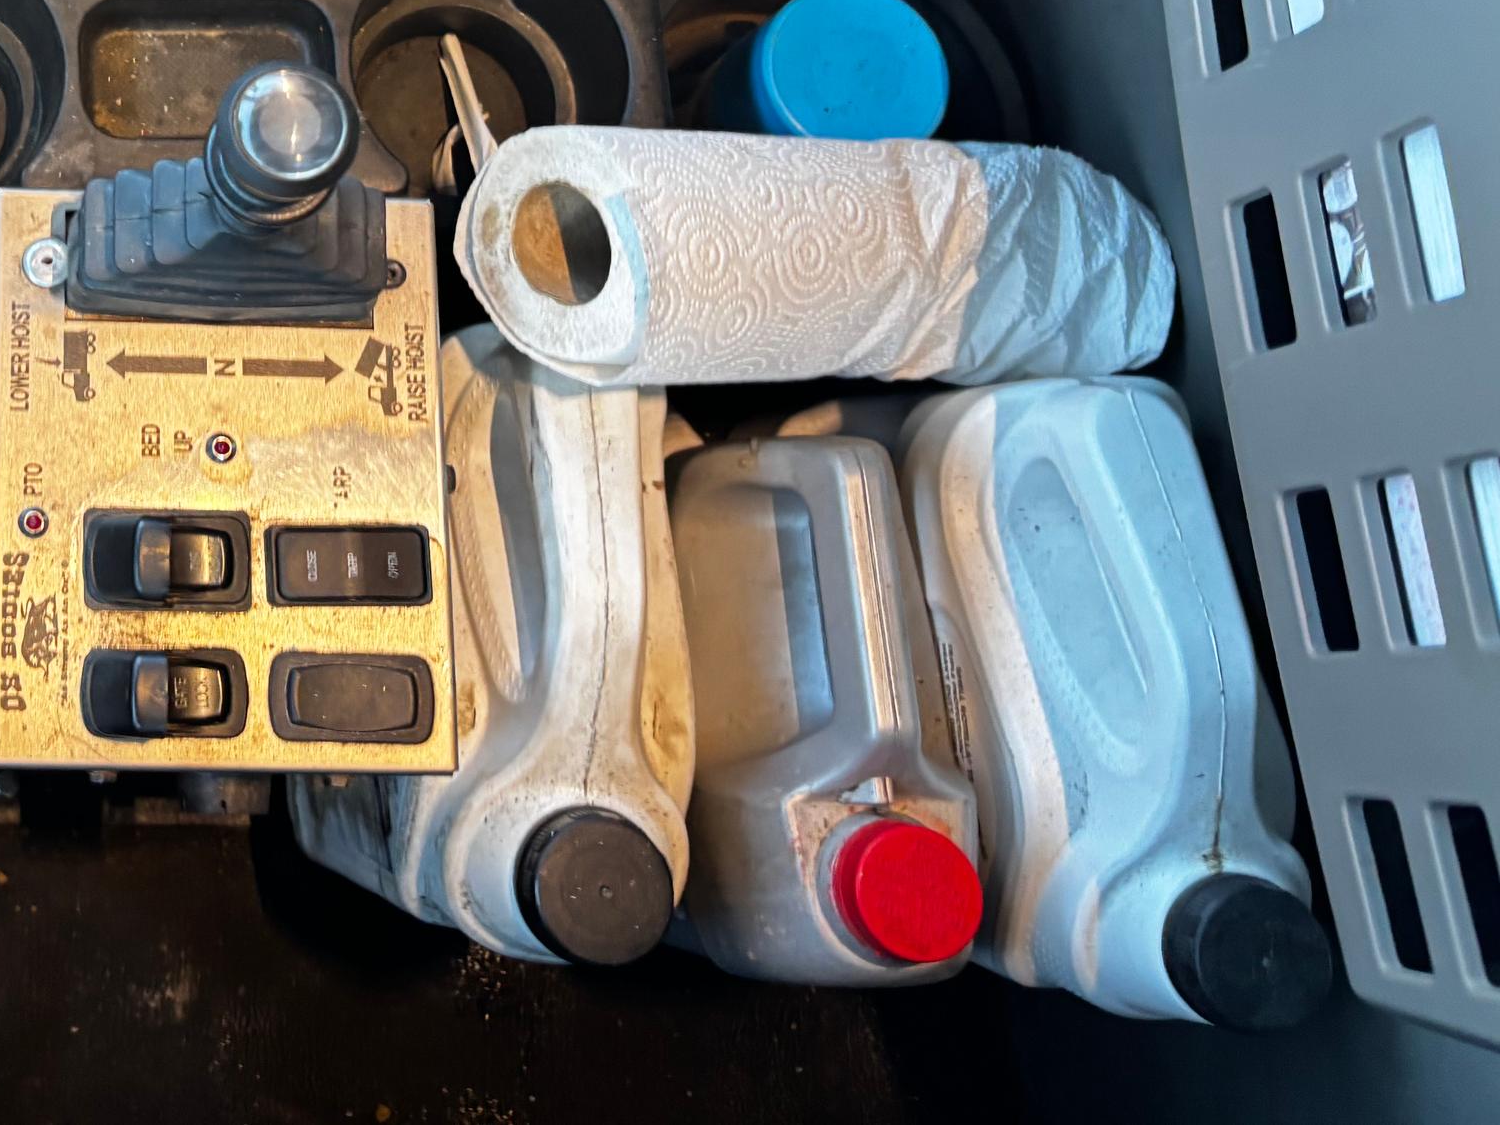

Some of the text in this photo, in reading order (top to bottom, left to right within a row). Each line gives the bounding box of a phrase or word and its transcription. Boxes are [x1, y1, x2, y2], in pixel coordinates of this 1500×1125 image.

[10, 301, 31, 411] LOWER HOIST
[214, 358, 236, 376] N
[404, 322, 428, 423] RAISE HOIST
[141, 423, 161, 457] BED
[173, 430, 193, 452] UP
[24, 462, 43, 496] PTO
[0, 553, 30, 711] OX BODIES
